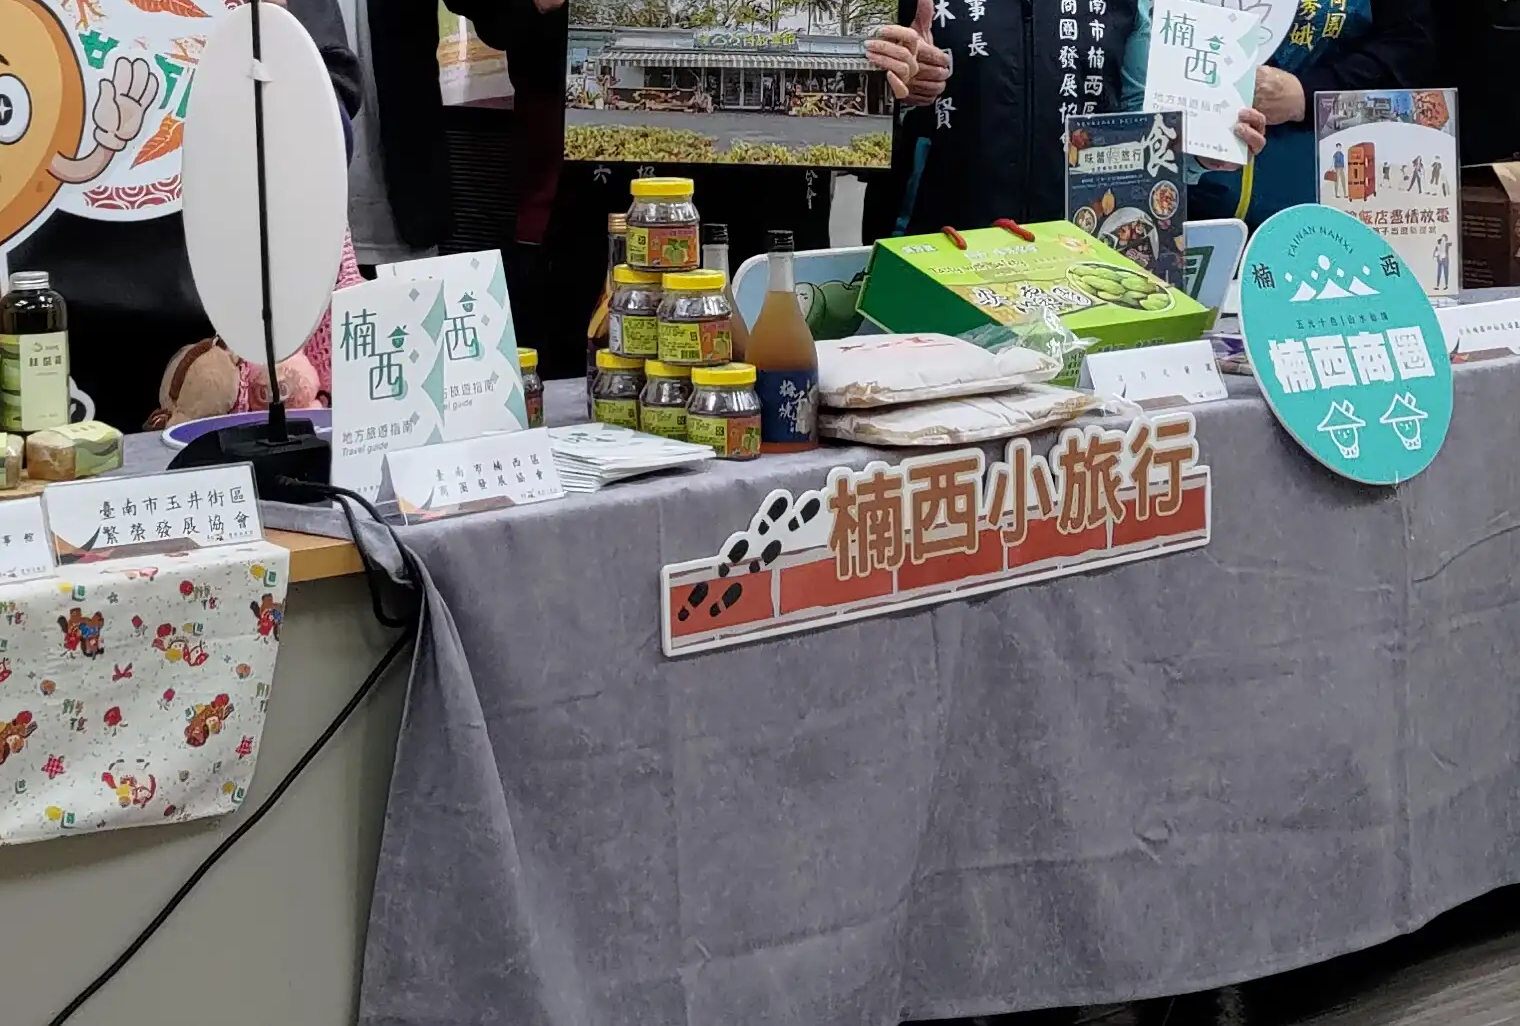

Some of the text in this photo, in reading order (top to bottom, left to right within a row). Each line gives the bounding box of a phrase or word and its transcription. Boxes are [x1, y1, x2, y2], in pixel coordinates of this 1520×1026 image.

[1142, 112, 1179, 177] 食
[1287, 225, 1356, 259] TAINAN NANXI
[340, 308, 405, 401] 楠西
[1267, 325, 1436, 395] 楠西商圈
[342, 420, 414, 444] 地方旅遊指南
[342, 440, 389, 457] Travel guide
[99, 485, 247, 521] 臺南市玉井街區
[829, 418, 1197, 578] 楠西小旅行
[102, 511, 250, 545] 繁榮發展協會
